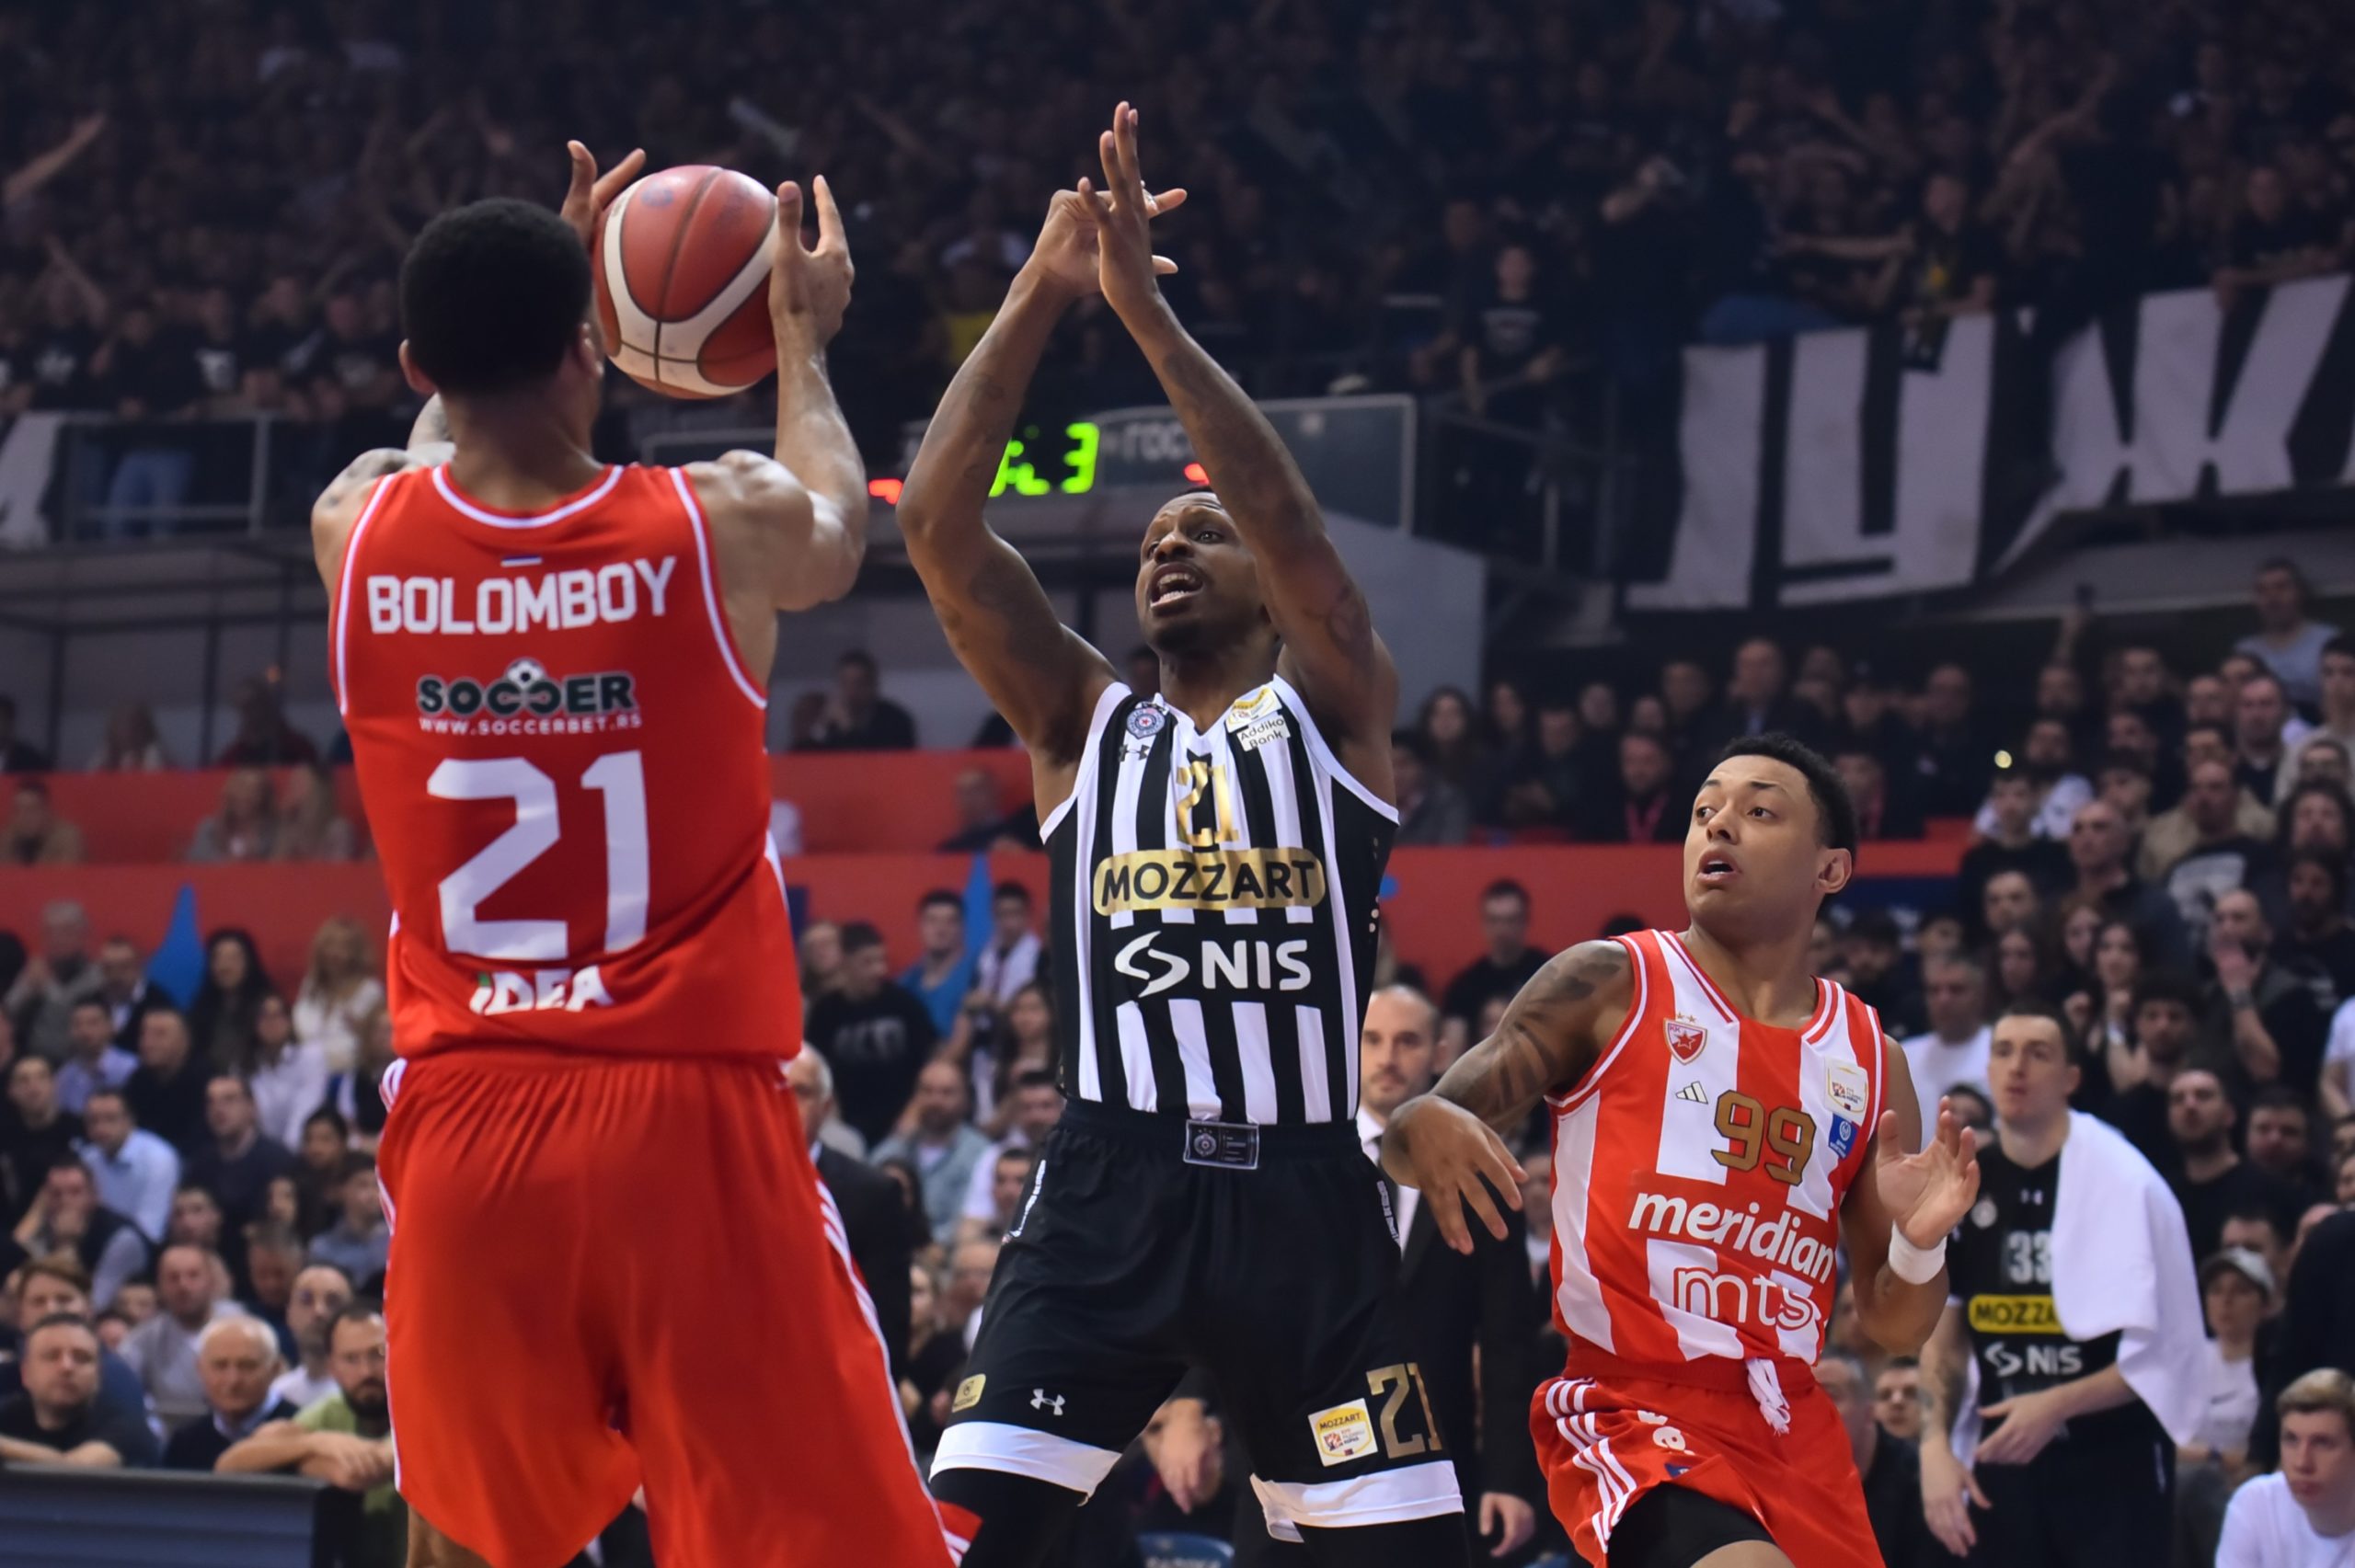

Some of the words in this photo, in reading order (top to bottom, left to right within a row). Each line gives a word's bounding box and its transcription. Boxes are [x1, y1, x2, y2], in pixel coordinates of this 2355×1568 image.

[367, 555, 676, 635] BOLOMBOY
[418, 673, 637, 716] SOCCER
[1241, 718, 1284, 740] Addiko
[1249, 729, 1282, 748] Bank
[1177, 761, 1239, 846] 21
[427, 750, 649, 961] 21
[1101, 860, 1315, 908] MOZZART
[1201, 938, 1312, 991] NIS
[1711, 1089, 1817, 1186] 99
[1628, 1193, 1836, 1284] meridian
[1674, 1266, 1816, 1331] mts
[2027, 1344, 2083, 1376] NIS
[1319, 1413, 1361, 1430] MOZZART
[1366, 1362, 1442, 1459] 21
